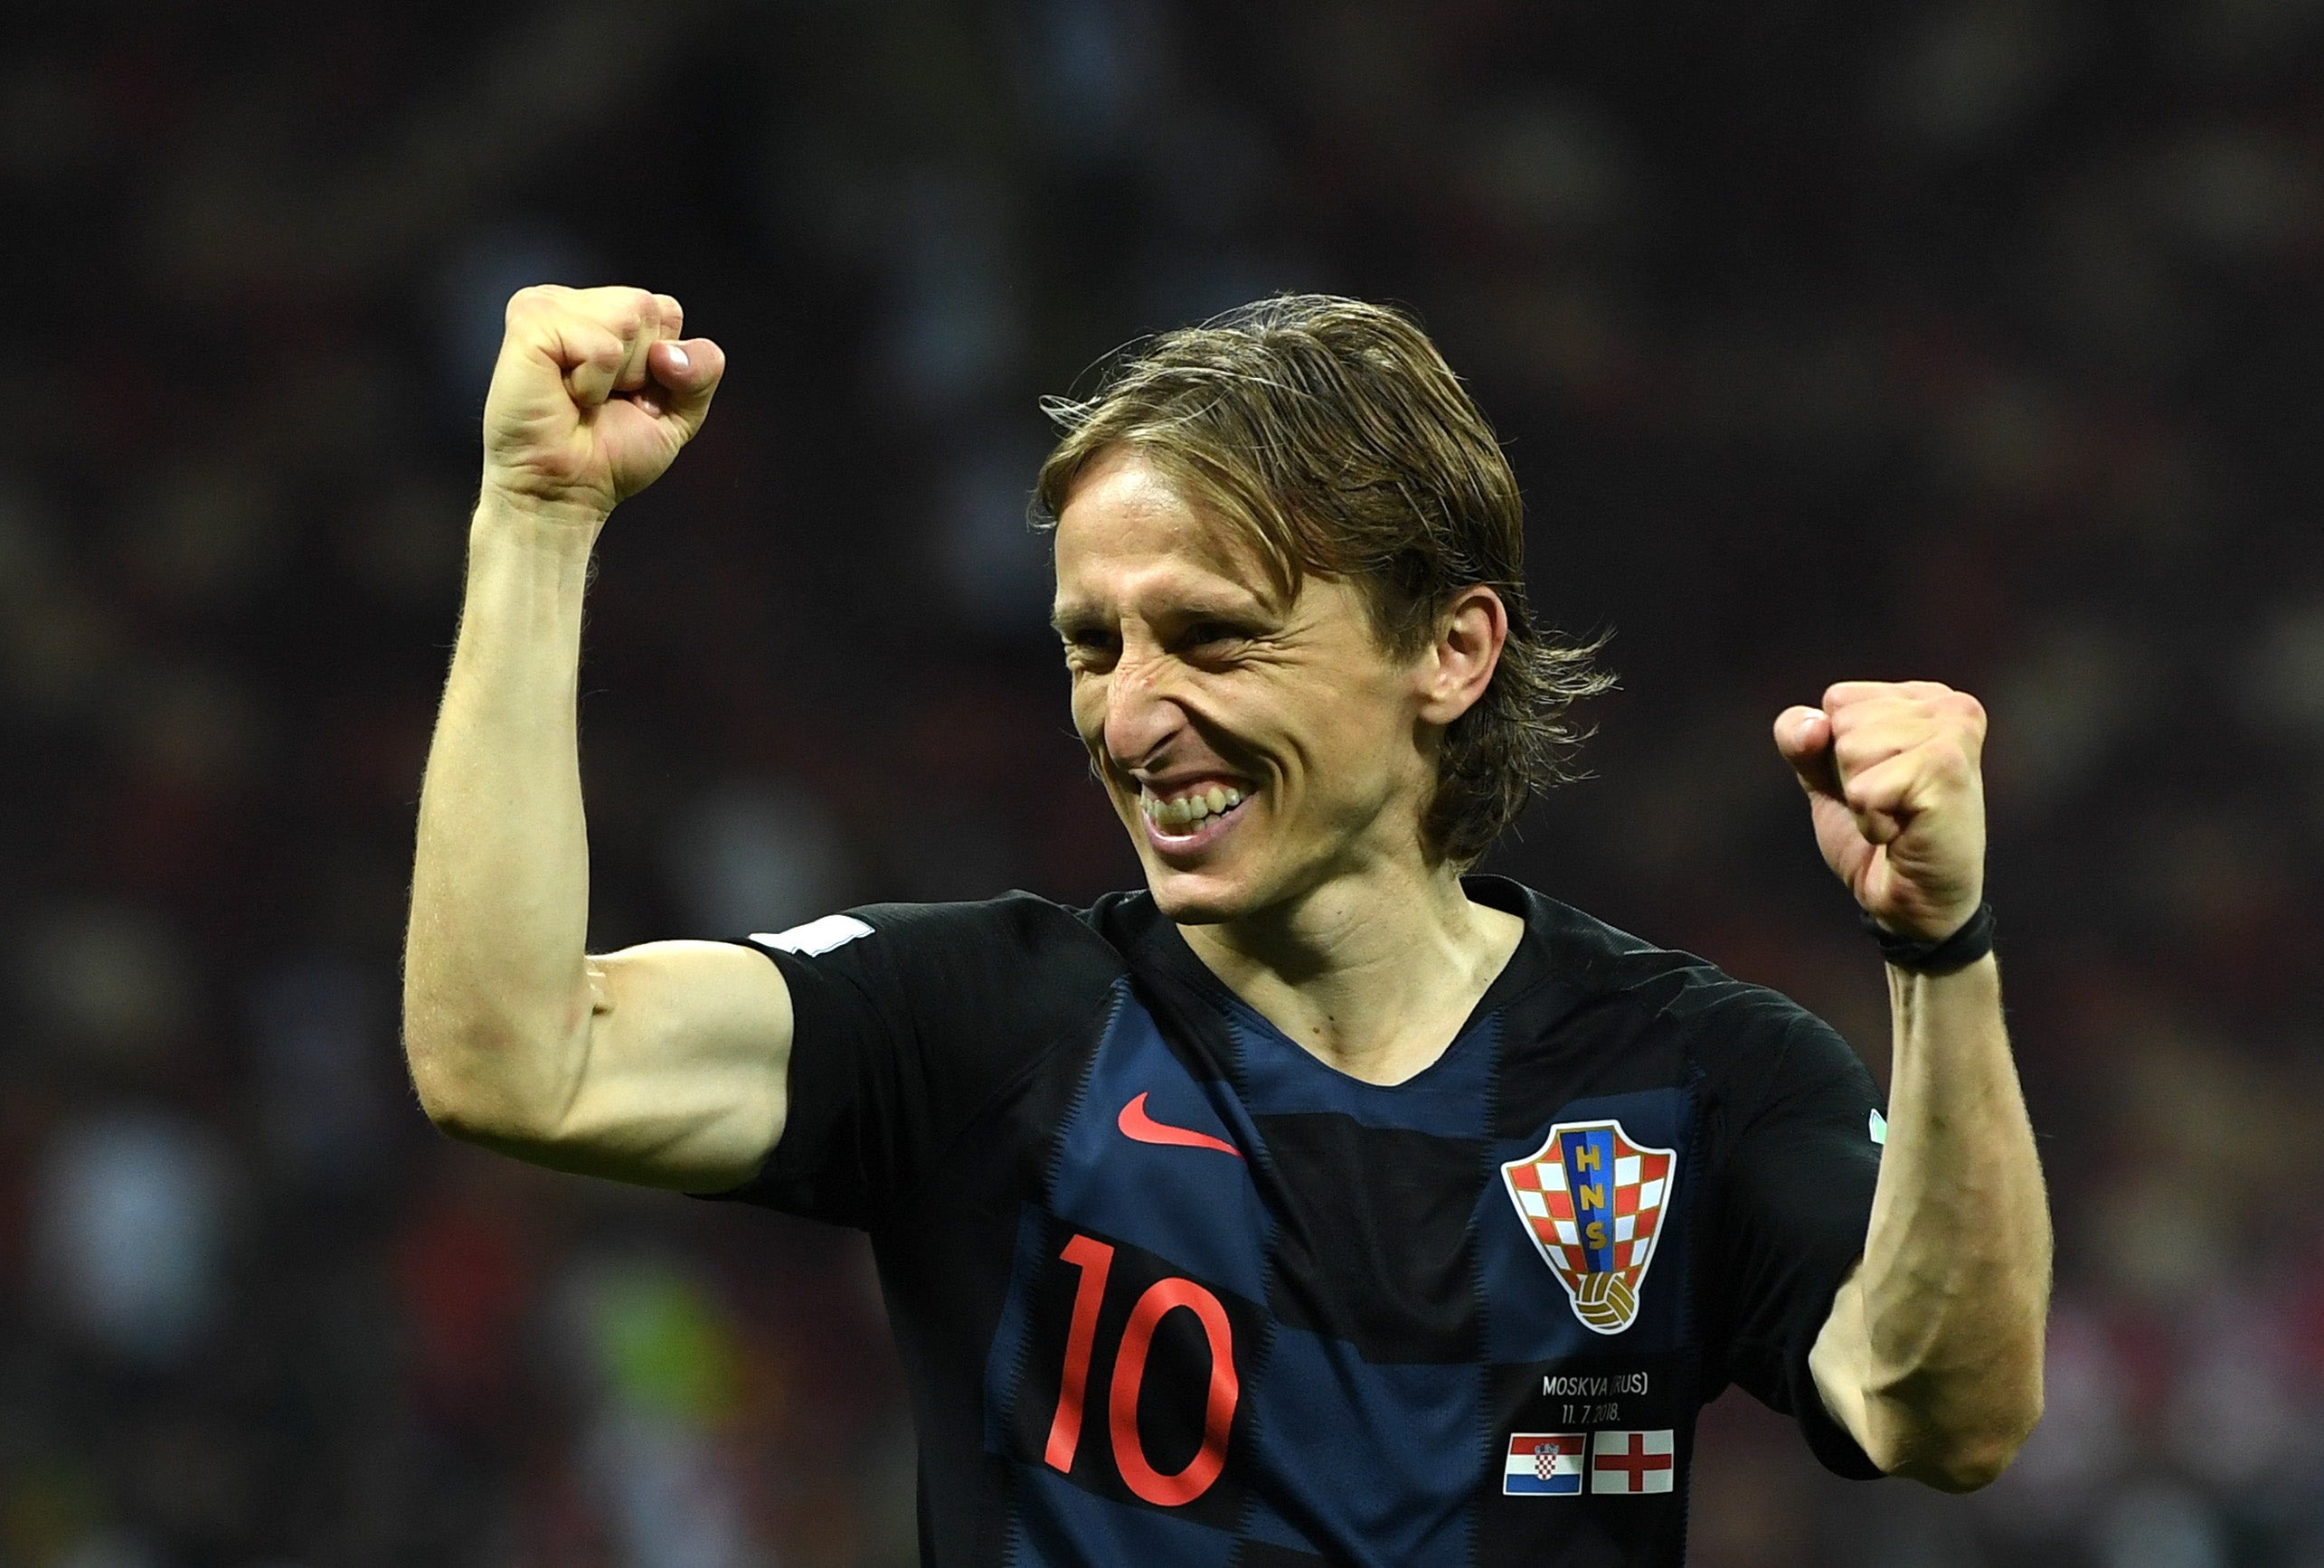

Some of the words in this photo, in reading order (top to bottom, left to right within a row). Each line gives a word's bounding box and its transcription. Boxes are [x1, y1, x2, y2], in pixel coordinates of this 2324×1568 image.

[1575, 1145, 1608, 1251] HNS
[1044, 1233, 1240, 1507] 10
[1543, 1375, 1608, 1396] MOSKVA
